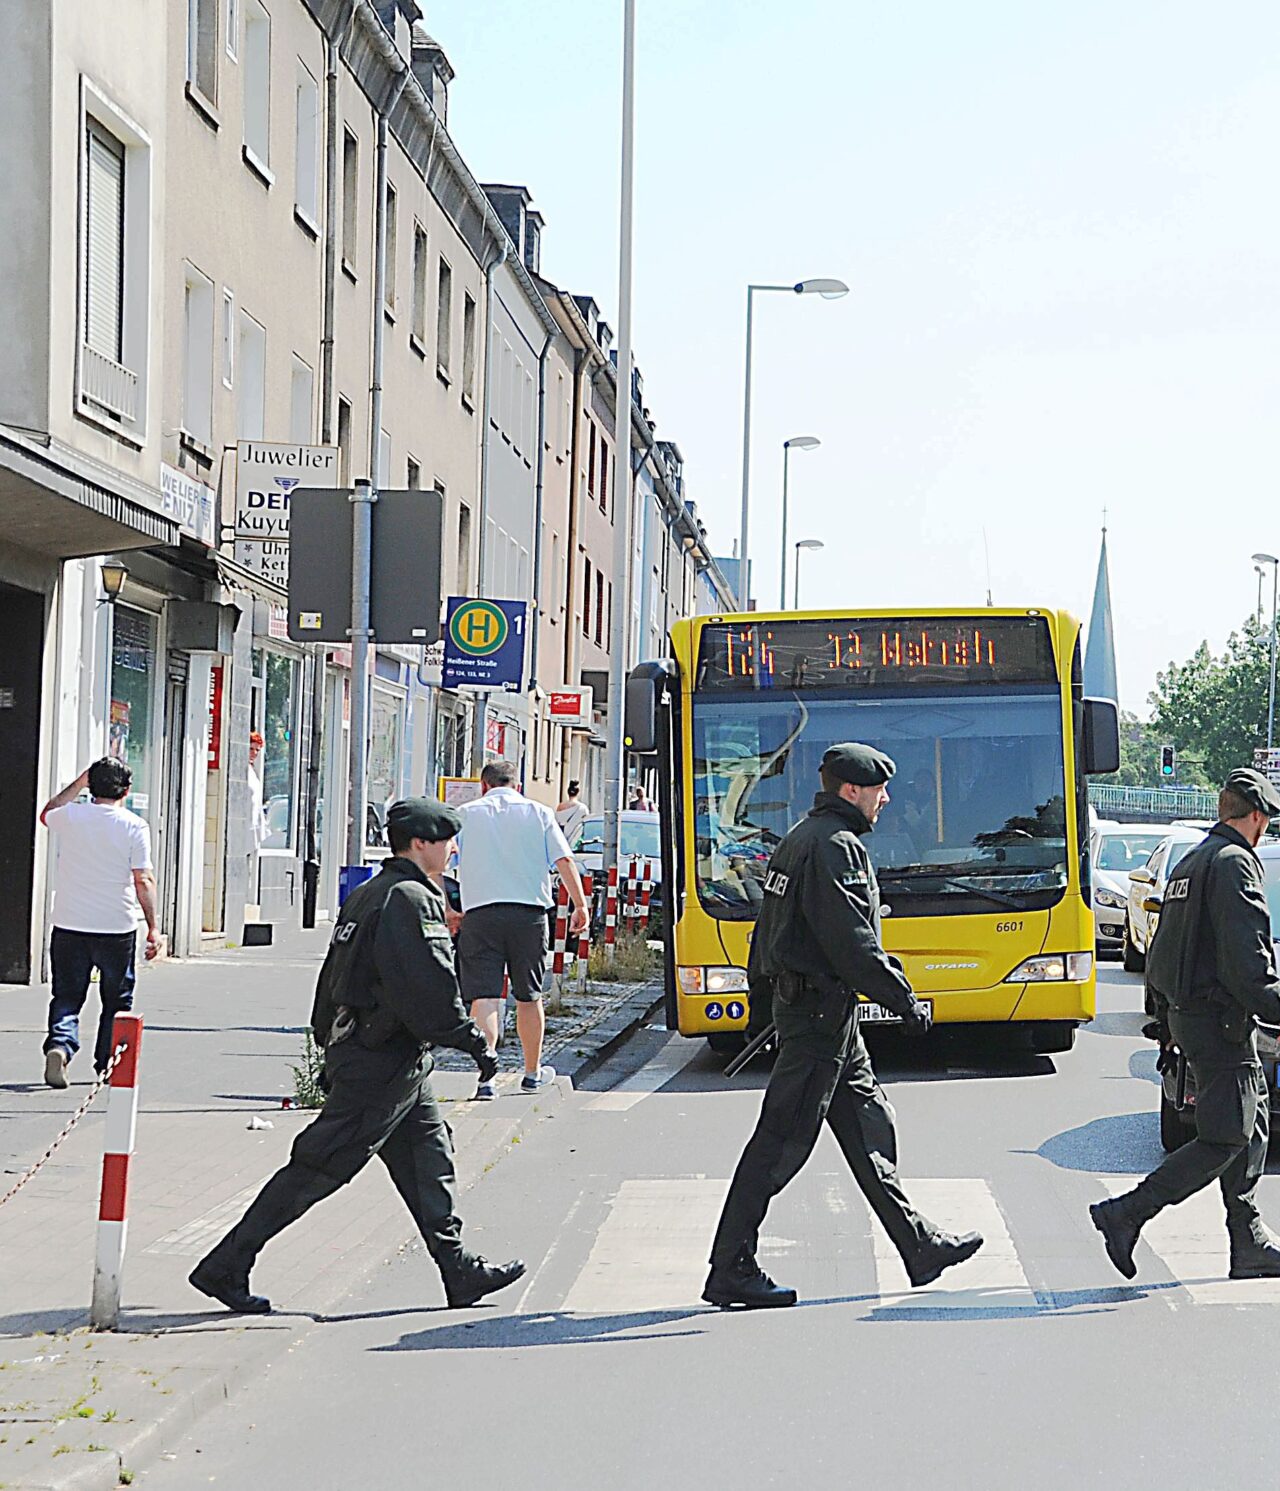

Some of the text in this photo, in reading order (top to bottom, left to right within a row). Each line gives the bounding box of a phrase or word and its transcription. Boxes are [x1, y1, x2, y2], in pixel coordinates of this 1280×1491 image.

[242, 444, 334, 469] Juwelier
[467, 613, 491, 643] H
[513, 615, 523, 635] 1
[446, 657, 498, 668] Heißener Straße
[996, 920, 1024, 932] 6601
[924, 962, 979, 970] CITARO
